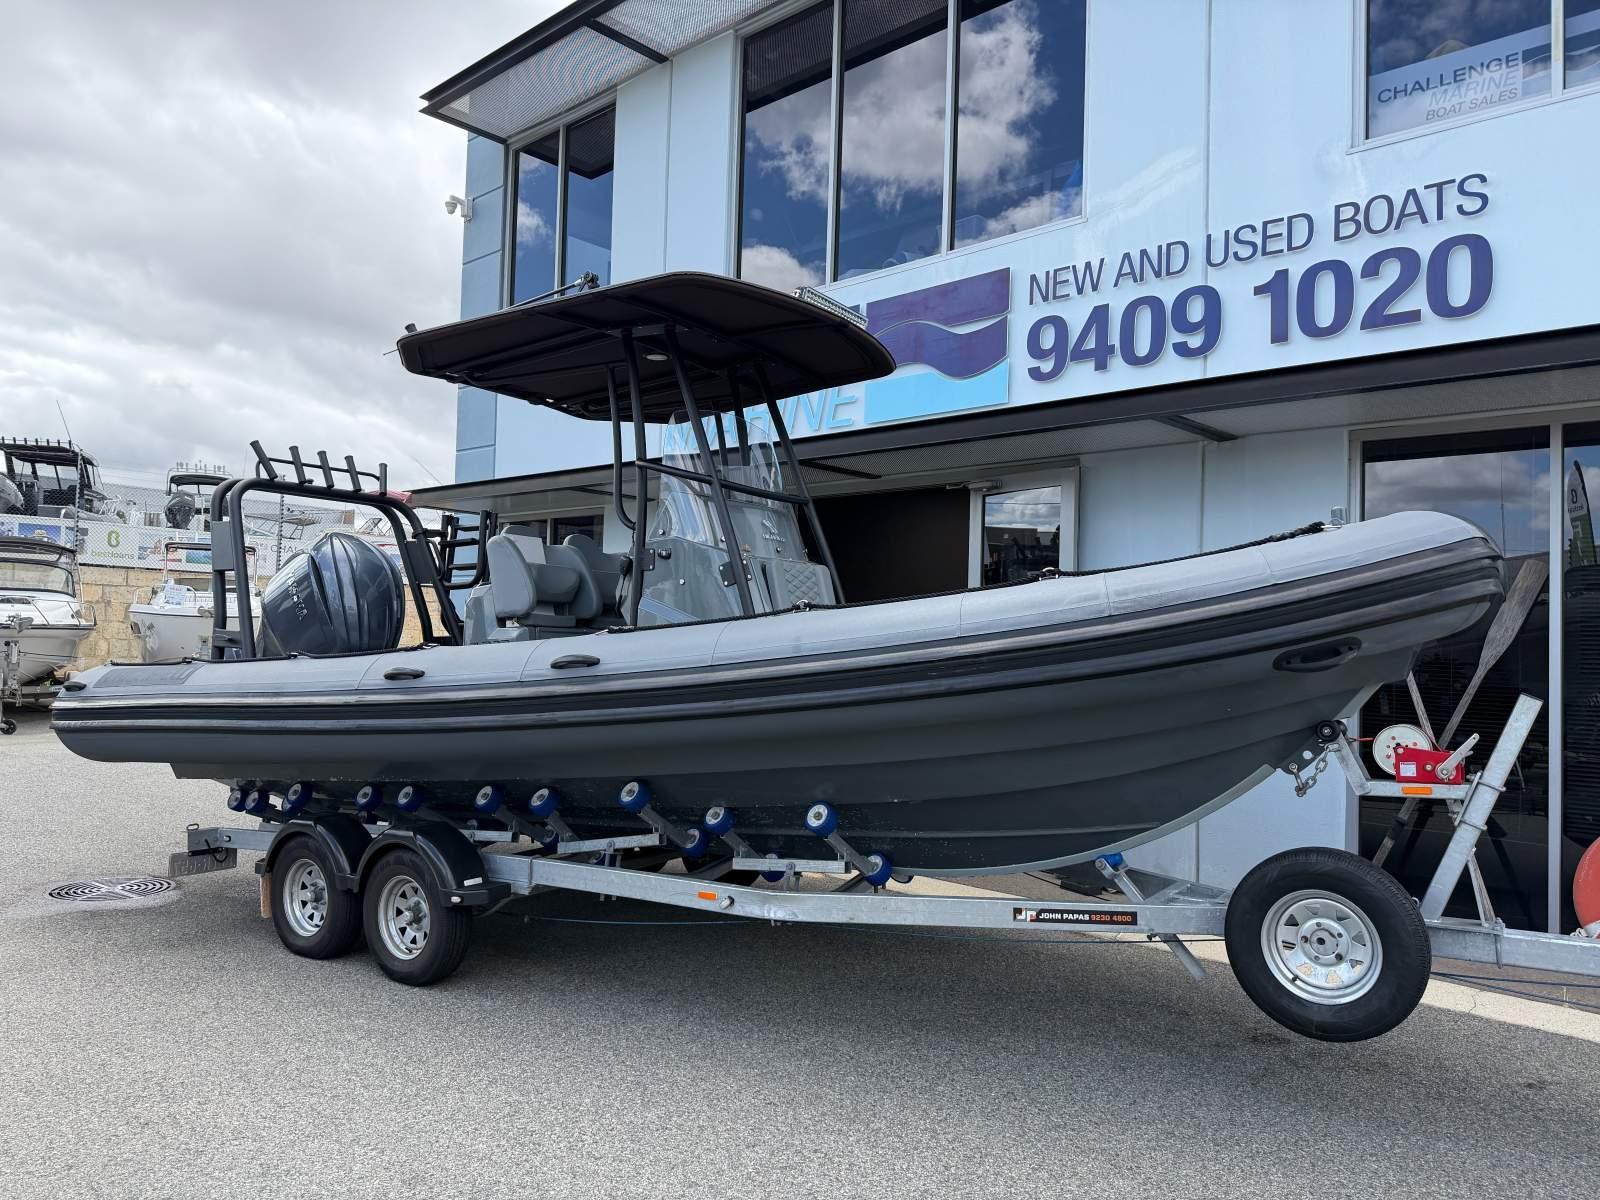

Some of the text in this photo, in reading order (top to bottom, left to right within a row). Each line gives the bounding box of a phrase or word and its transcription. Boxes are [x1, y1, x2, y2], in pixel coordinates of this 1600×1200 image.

[1377, 52, 1520, 103] CHALLENGE
[1428, 69, 1520, 106] MARINE
[1426, 87, 1518, 121] BOAT SALES
[1029, 173, 1489, 305] NEW AND USED BOATS
[1026, 233, 1494, 382] 9409 1020
[667, 387, 856, 449] MARNE
[1039, 912, 1061, 920] JOHN
[1063, 913, 1089, 921] PAPAS
